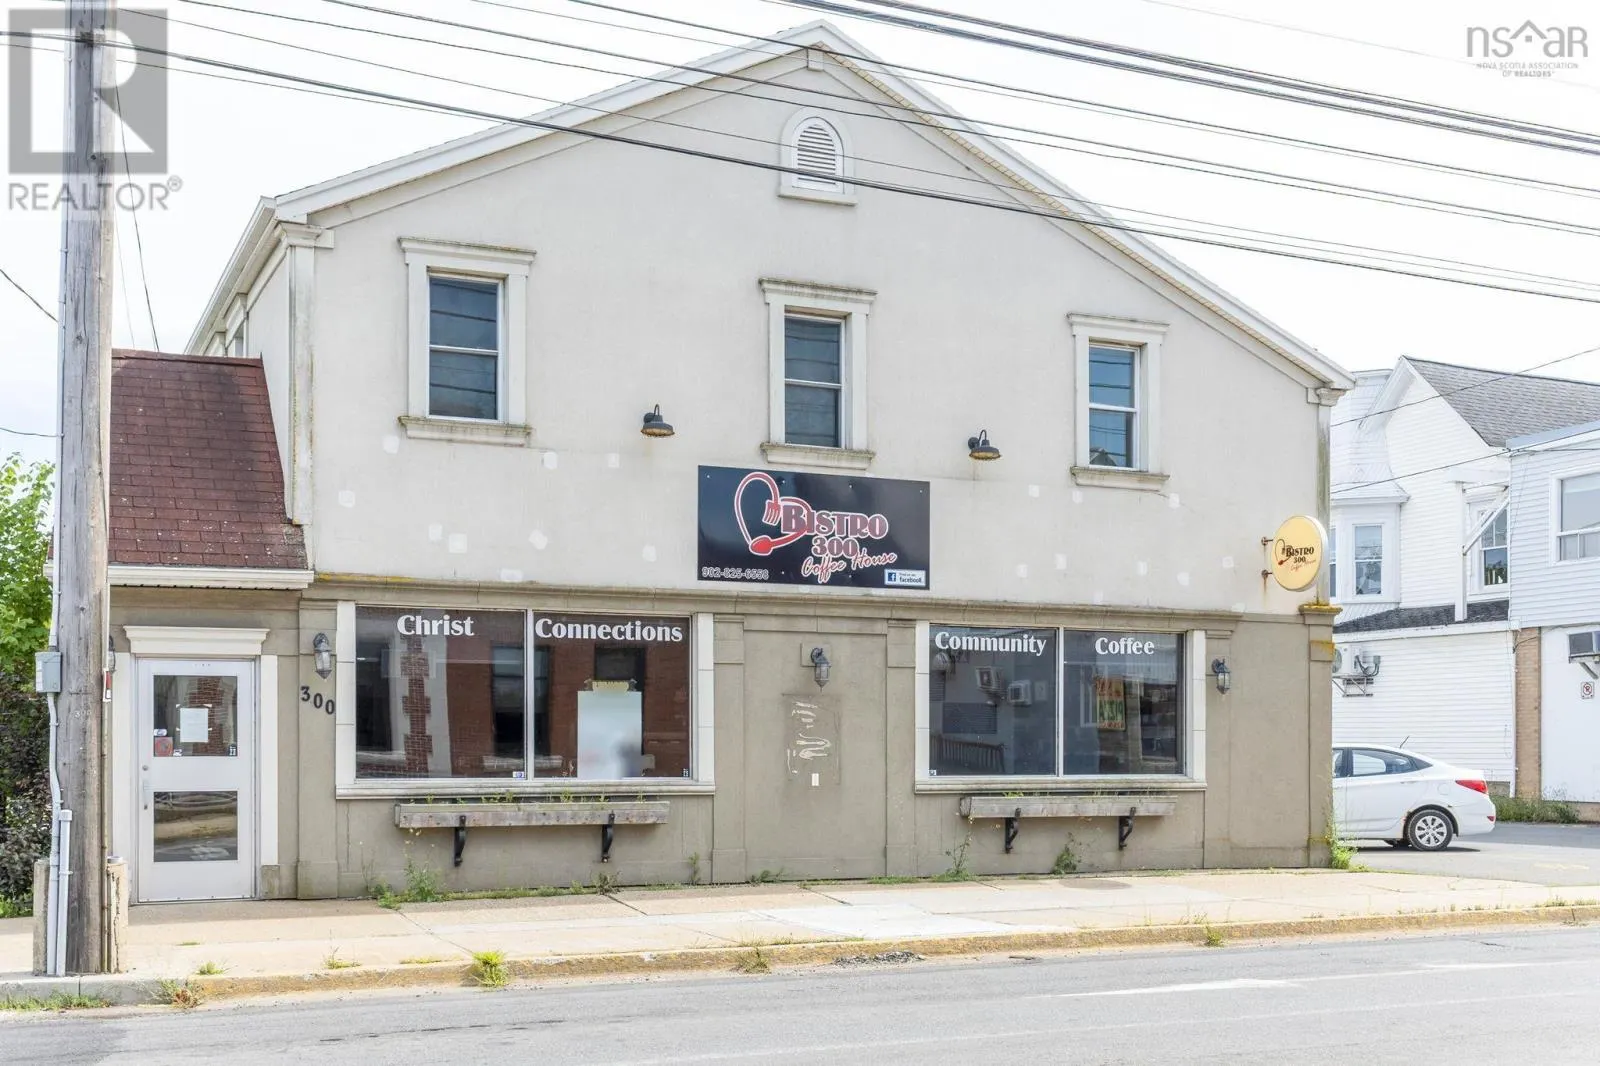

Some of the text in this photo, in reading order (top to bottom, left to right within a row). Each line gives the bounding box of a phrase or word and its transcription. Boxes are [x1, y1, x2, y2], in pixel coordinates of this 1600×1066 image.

[781, 502, 889, 539] BISTRO
[811, 536, 860, 559] 300
[1286, 546, 1315, 558] BISTRO
[1293, 556, 1306, 564] 300
[801, 547, 897, 584] Coffee House
[397, 614, 683, 642] Christ Connections
[935, 631, 1155, 656] Community Coffee
[300, 686, 336, 715] 300
